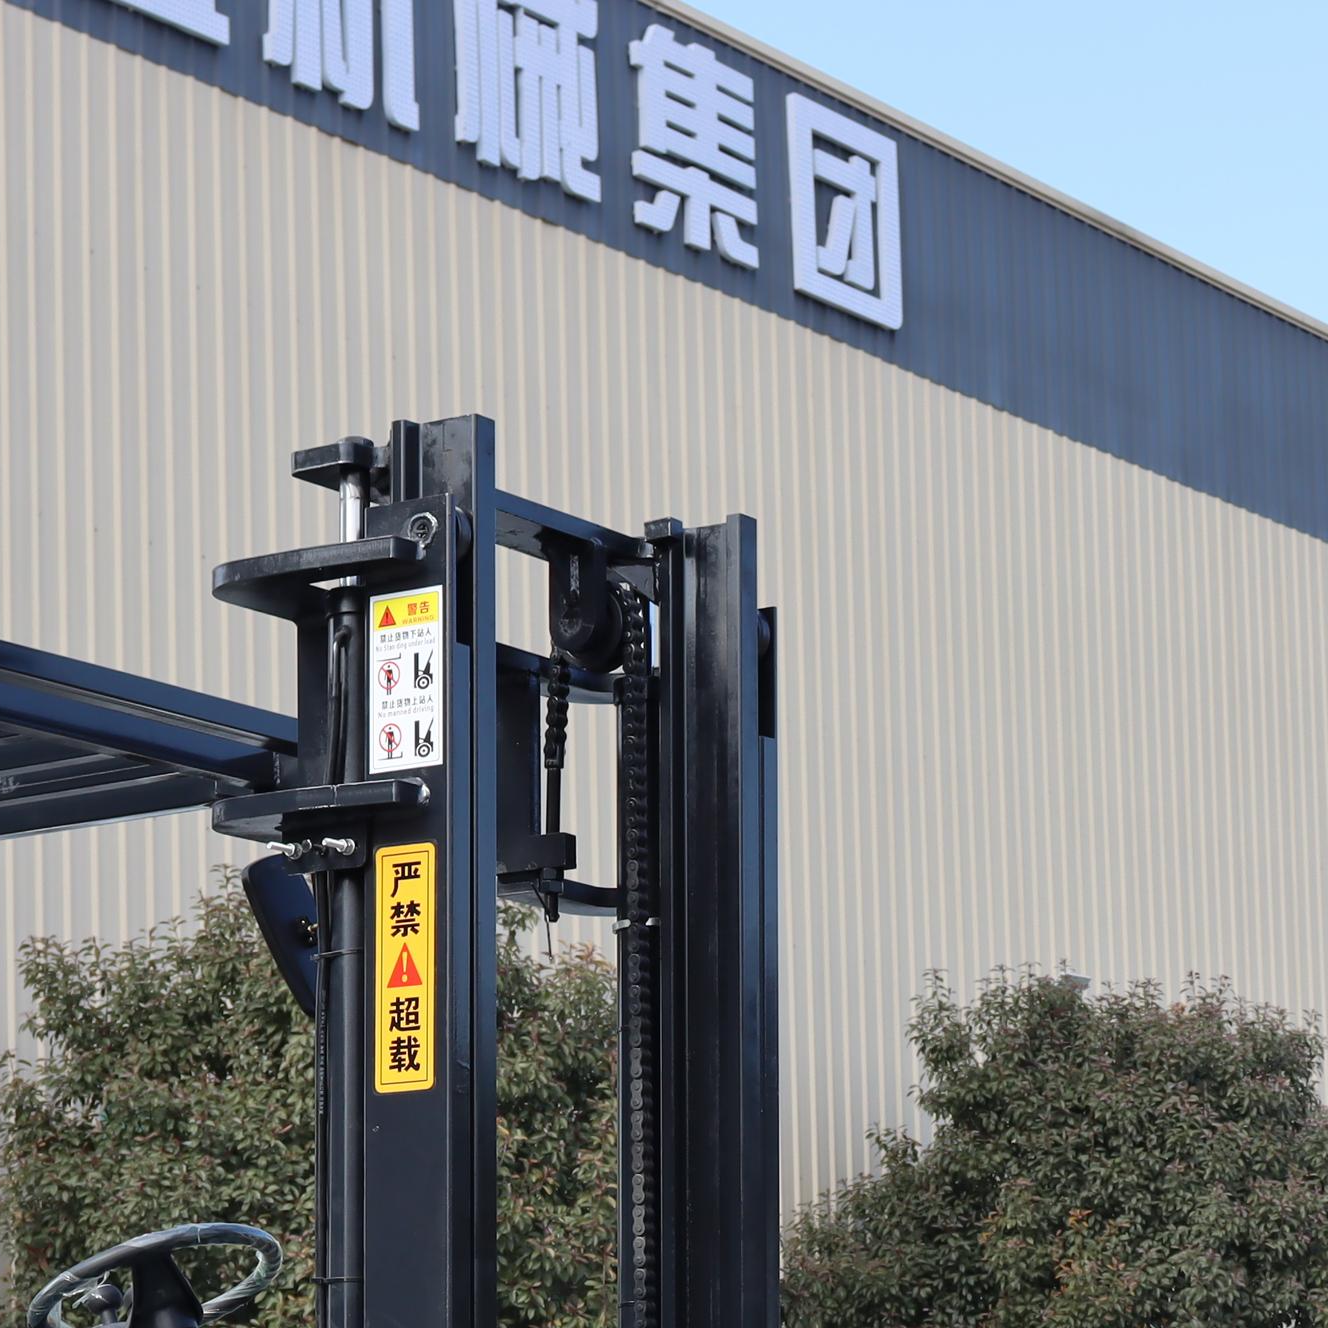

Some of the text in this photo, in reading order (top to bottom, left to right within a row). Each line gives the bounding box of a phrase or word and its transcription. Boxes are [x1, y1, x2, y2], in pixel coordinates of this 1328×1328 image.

[105, 0, 903, 330] 械集团
[407, 601, 430, 616] 警告
[388, 860, 422, 1073] 严禁 超载
